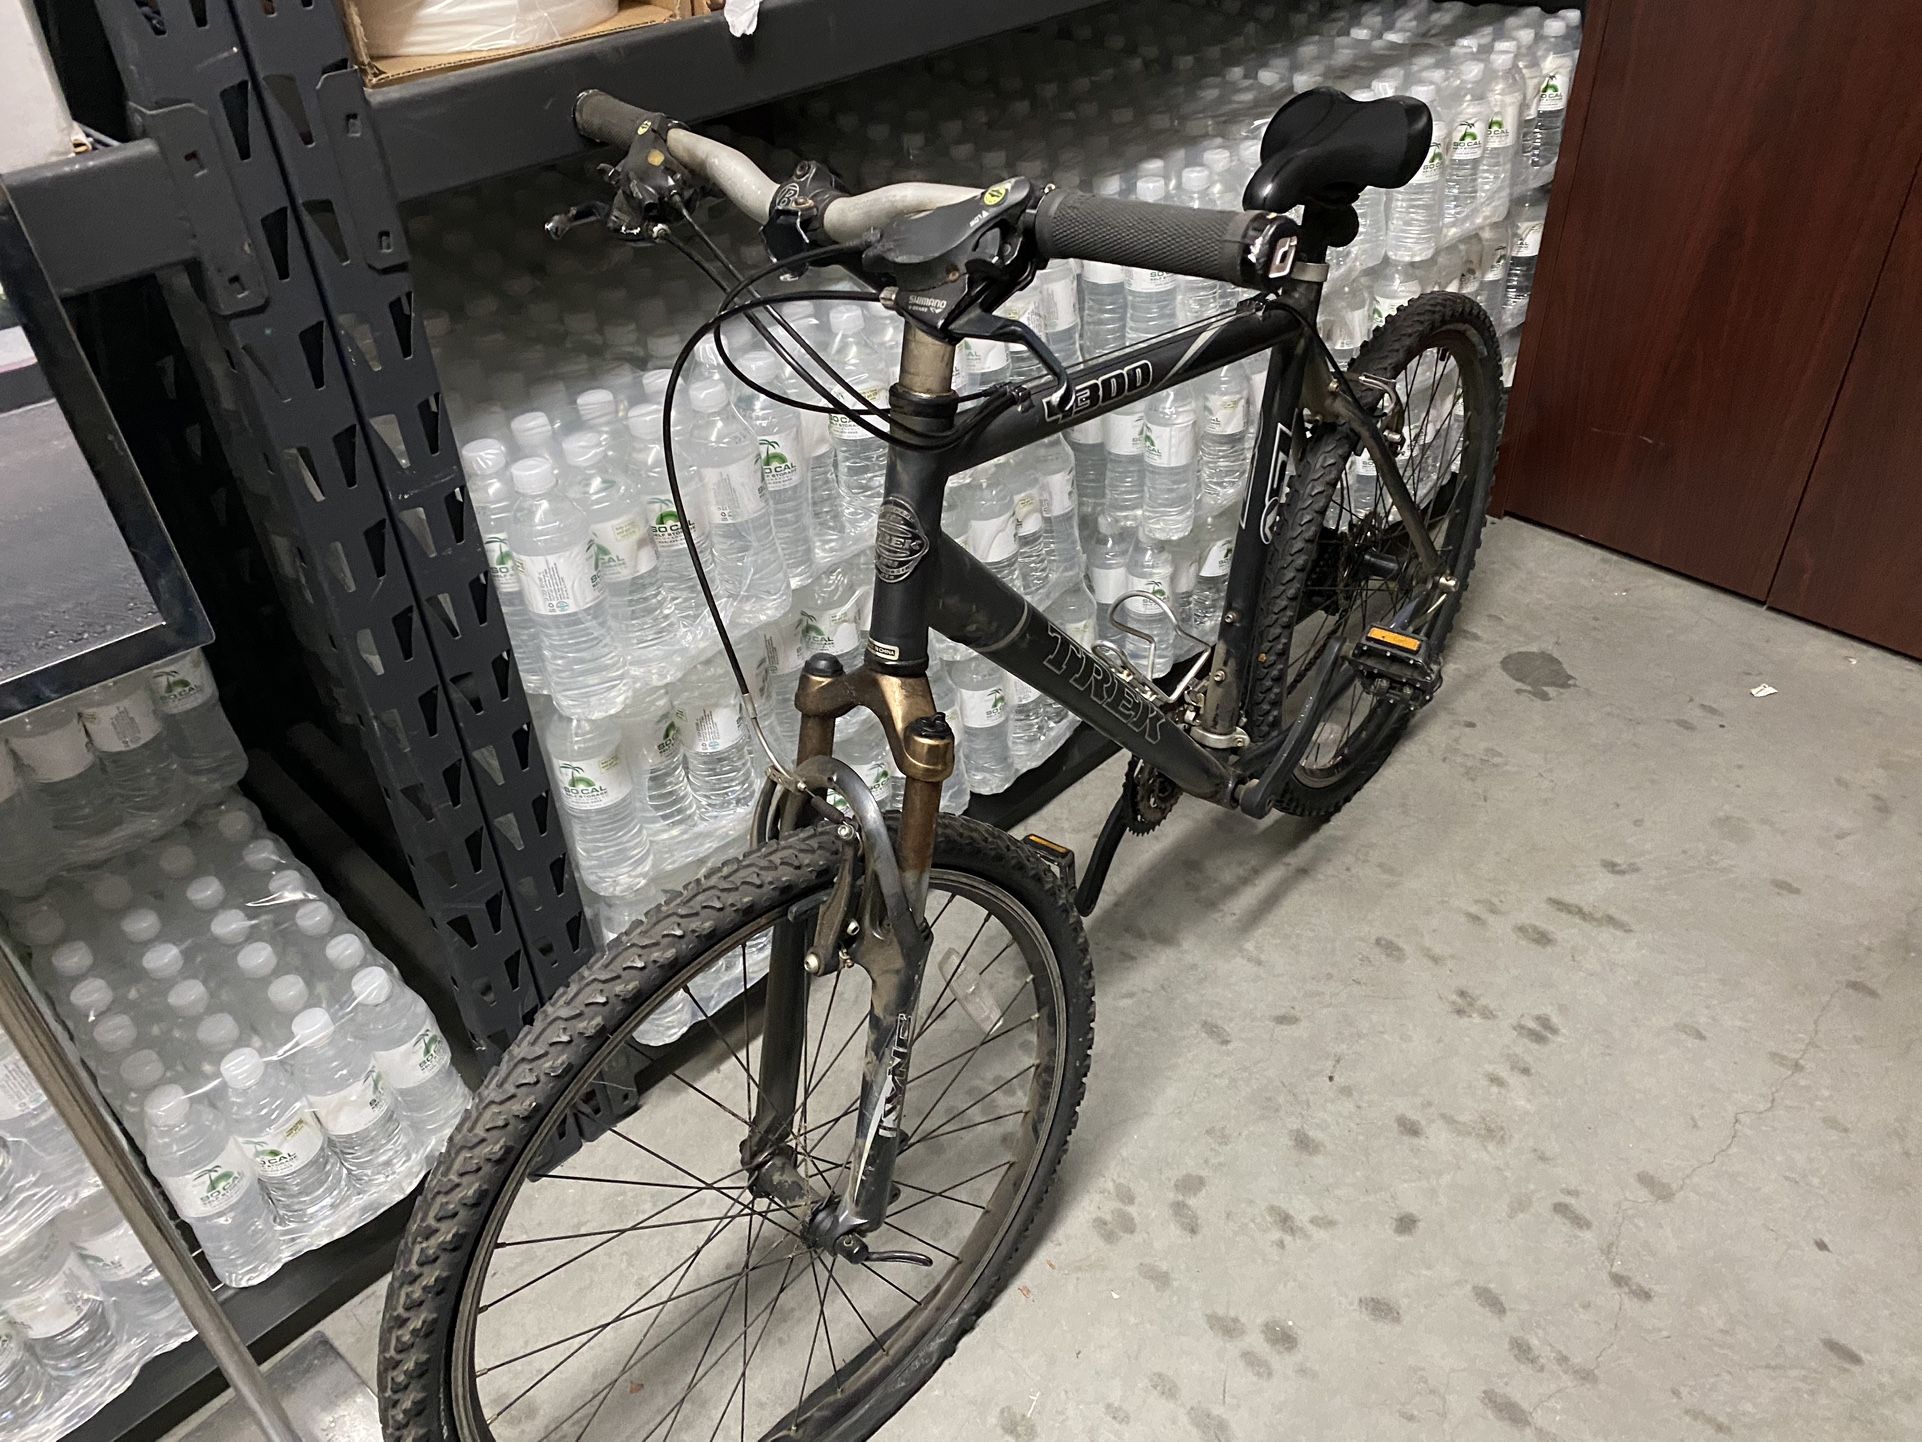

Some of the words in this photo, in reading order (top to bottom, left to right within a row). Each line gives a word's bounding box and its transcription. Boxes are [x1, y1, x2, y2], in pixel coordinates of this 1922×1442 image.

[909, 295, 947, 309] SHIMANO
[774, 463, 797, 473] CAL
[1043, 620, 1166, 744] TREK
[580, 785, 607, 795] CAL
